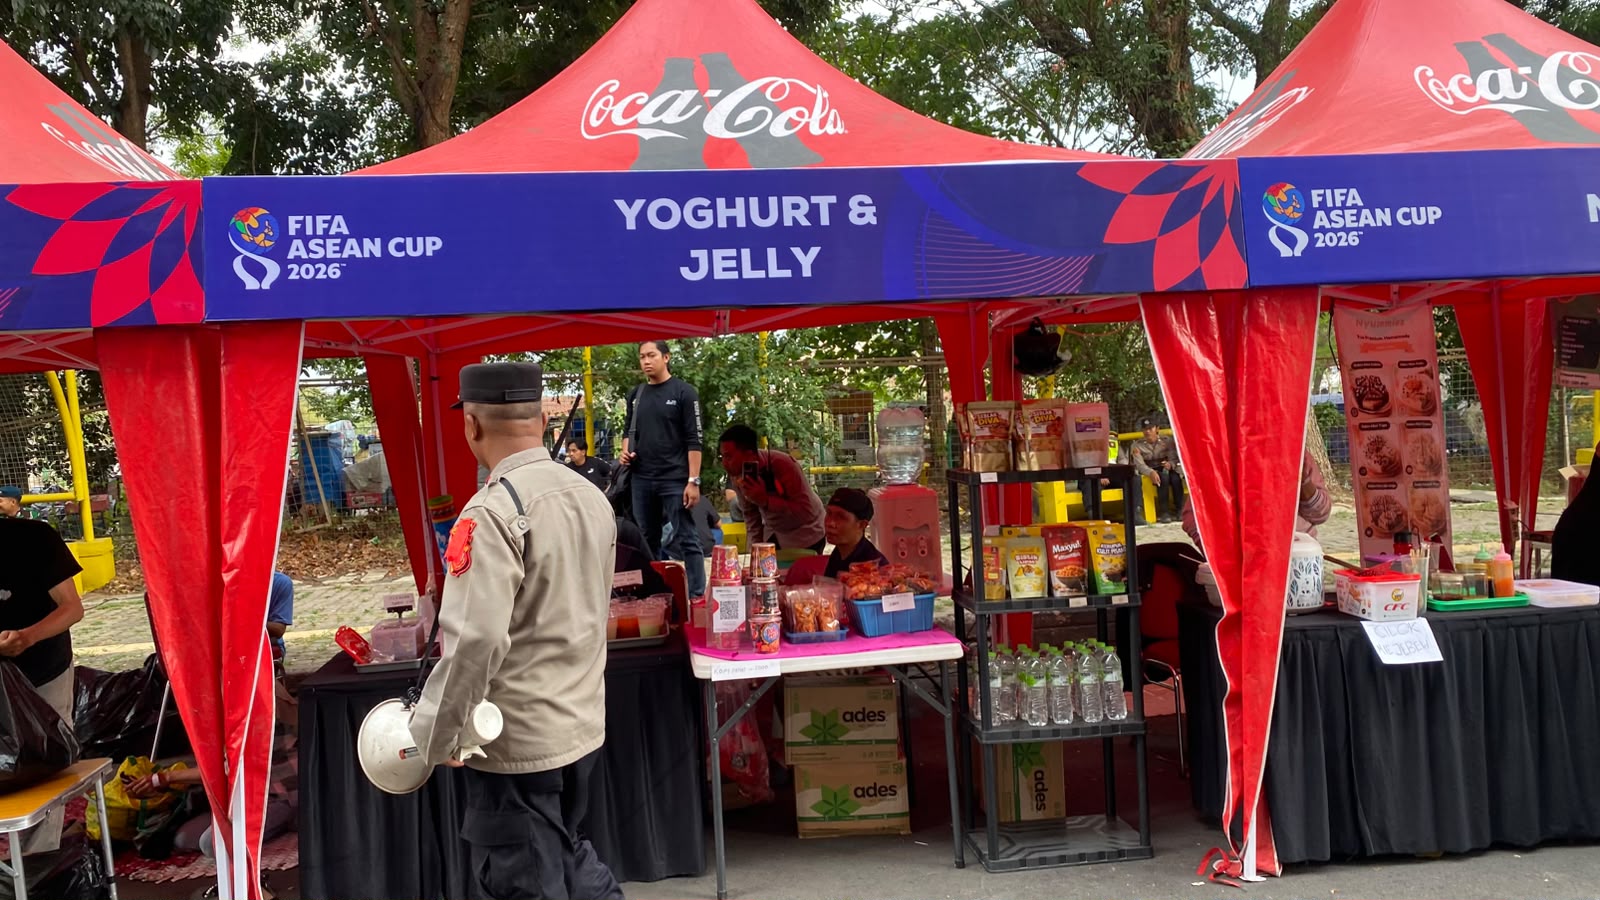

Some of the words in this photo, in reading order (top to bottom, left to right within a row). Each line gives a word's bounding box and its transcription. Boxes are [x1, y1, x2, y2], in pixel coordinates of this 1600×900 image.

[580, 76, 846, 141] Coca-Cola
[1311, 188, 1364, 208] FIFA
[613, 195, 838, 230] YOGHURT
[848, 194, 878, 226] &
[1312, 207, 1393, 230] ASEAN
[1396, 206, 1443, 226] CUP
[287, 214, 350, 236] FIFA
[286, 237, 382, 260] ASEAN
[387, 236, 443, 258] CUP
[679, 246, 822, 282] JELLY
[842, 707, 886, 723] ades
[853, 782, 897, 799] ades
[1034, 769, 1049, 812] ades
